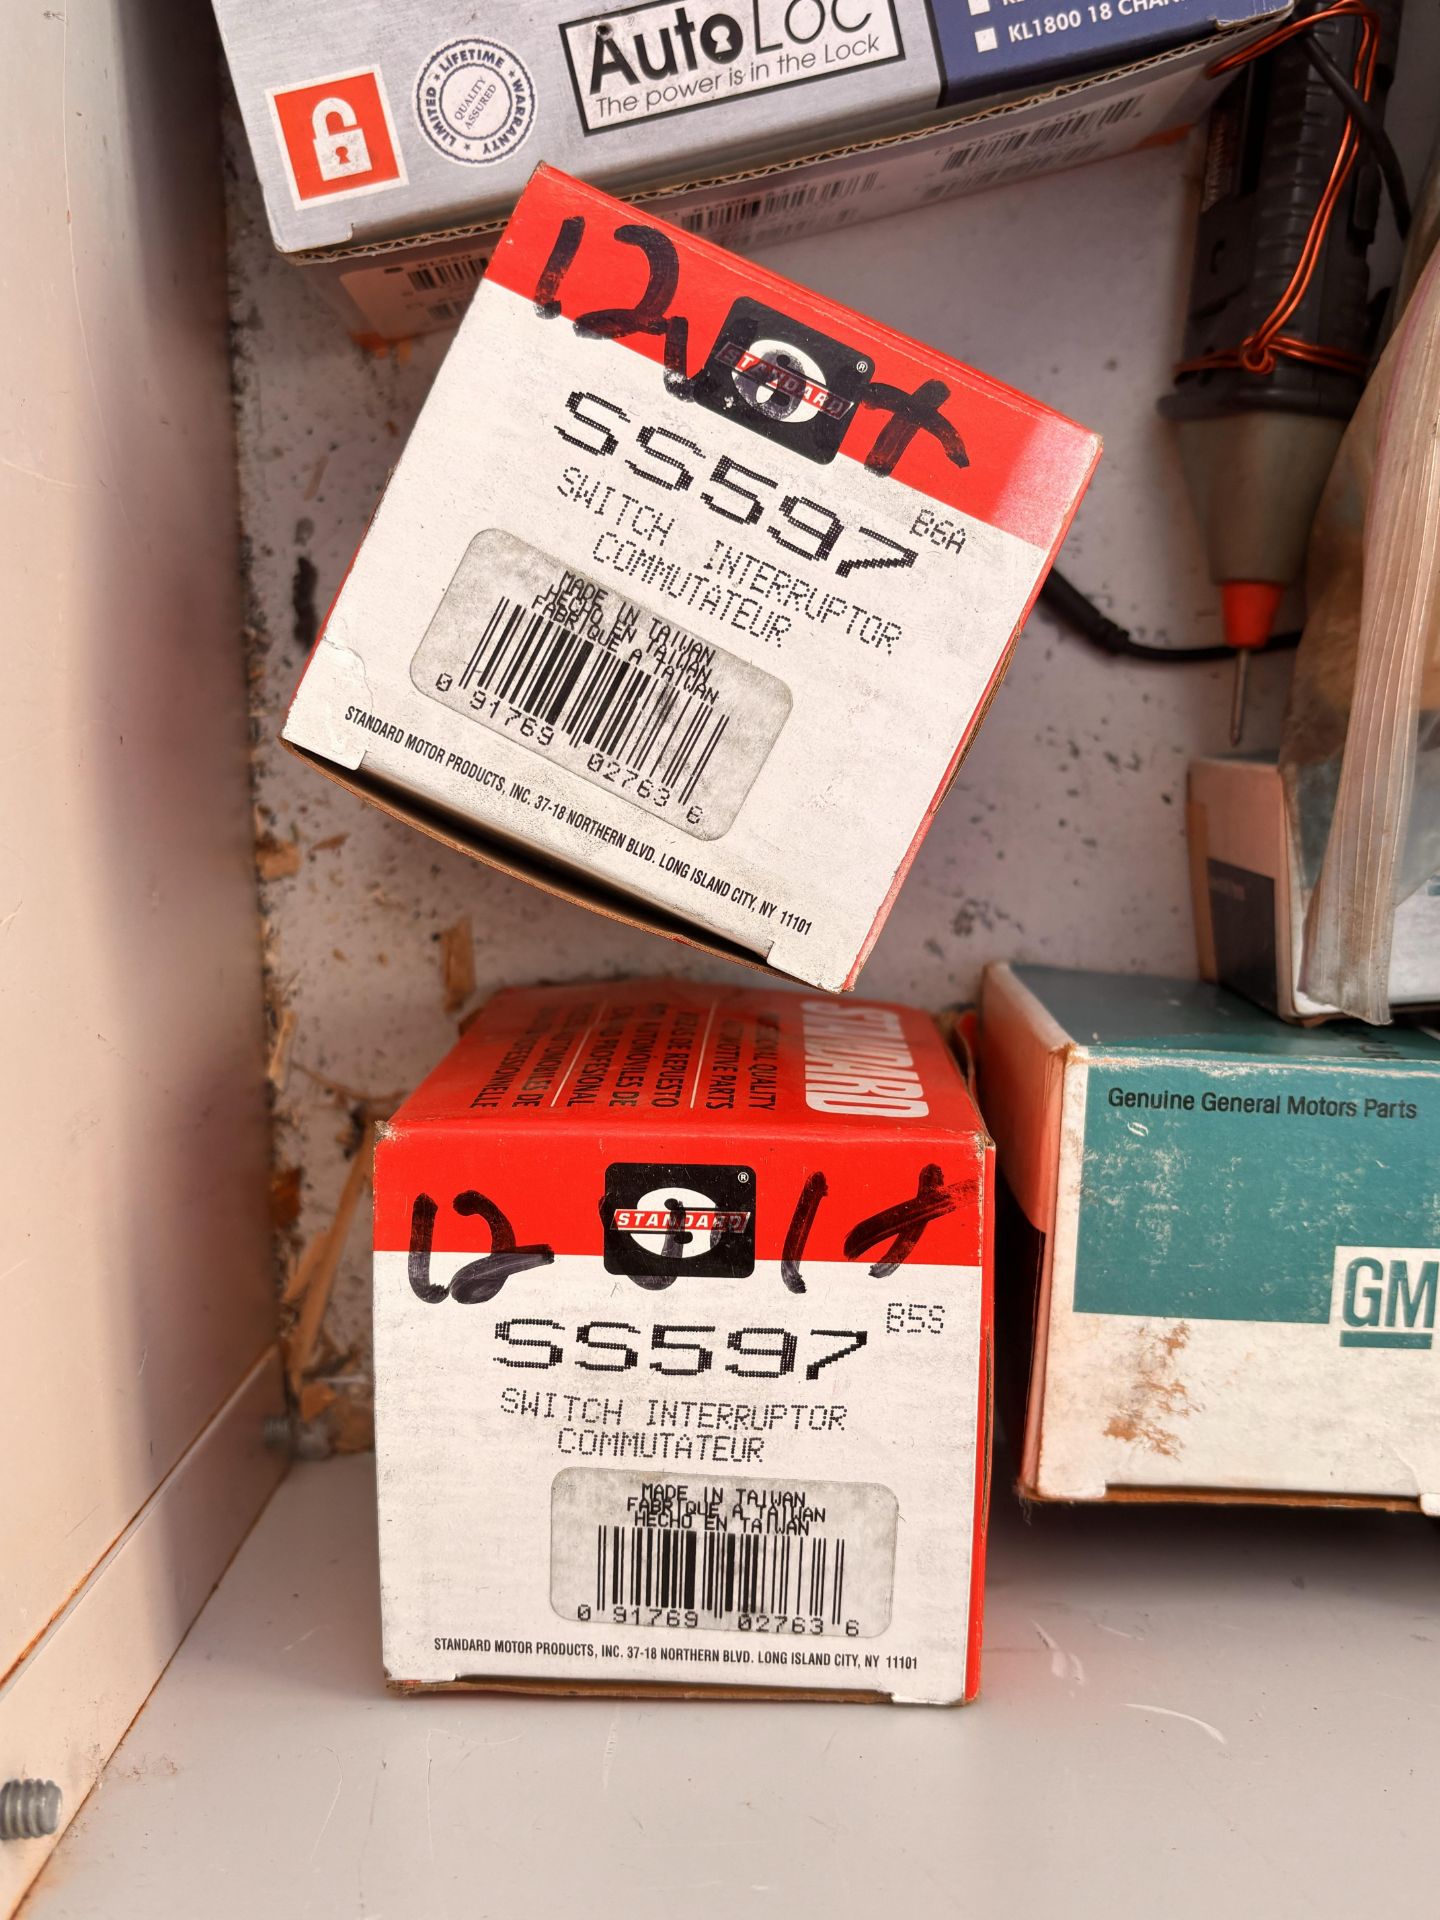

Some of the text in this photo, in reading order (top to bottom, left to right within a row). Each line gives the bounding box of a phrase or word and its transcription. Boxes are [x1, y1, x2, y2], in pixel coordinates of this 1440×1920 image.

[1008, 10, 1081, 42] KL1800
[1087, 2, 1112, 22] 18
[439, 49, 505, 73] LIFETIME
[596, 33, 880, 118] The power is in the Lock
[426, 86, 457, 147] LIMITED
[454, 75, 486, 121] QUALITY
[464, 83, 497, 130] ASSURED
[482, 78, 526, 154] WARRANTY
[554, 391, 919, 578] SS597
[909, 509, 966, 555] B6A
[557, 466, 902, 655] SWITCH INTERRUPTOR
[592, 531, 792, 648] COMMUTATEUR
[549, 584, 713, 681] HECHO EN TAIWAN
[564, 570, 715, 665] MADE IN TAIWAN
[533, 595, 625, 653] FABRIQUE
[654, 658, 720, 705] TAIWAN
[435, 673, 703, 825] 0 91769 02763 6
[345, 705, 812, 935] STANDARD MOTOR PRODUCTS, INC. 37-18 NORTHERN BLVD. LONG ISLAND CITY, NY 11101
[566, 1039, 621, 1107] PROFESIONAL
[651, 1052, 690, 1108] REPUESTO
[801, 1000, 929, 1118] STANDARD
[511, 1093, 544, 1108] DE
[608, 1091, 639, 1107] DE
[705, 1074, 736, 1110] PARTS
[748, 1062, 778, 1111] QUALITY
[1107, 1087, 1417, 1119] Genuine General Motors Parts
[617, 1213, 741, 1229] STANDARD
[1342, 1256, 1440, 1328] GM
[887, 1303, 945, 1334] B5S
[493, 1319, 867, 1380] SS597
[501, 1388, 847, 1431] SWITCH INTERRUPTOR
[558, 1426, 764, 1462] COMMUTATEUR
[627, 1497, 719, 1516] FABRIQUE
[756, 1504, 825, 1522] TAIWAN
[641, 1483, 805, 1507] MADE IN TAIWAN
[634, 1511, 809, 1536] HECHO EN TAIWAN
[577, 1605, 859, 1637] 0 91769 02763 6
[435, 1638, 916, 1669] STANDARD MOTOR PRODUCTS, INC. 37-18 NORTHERN BLVD. LONG ISLAND CITY, NY 11101
